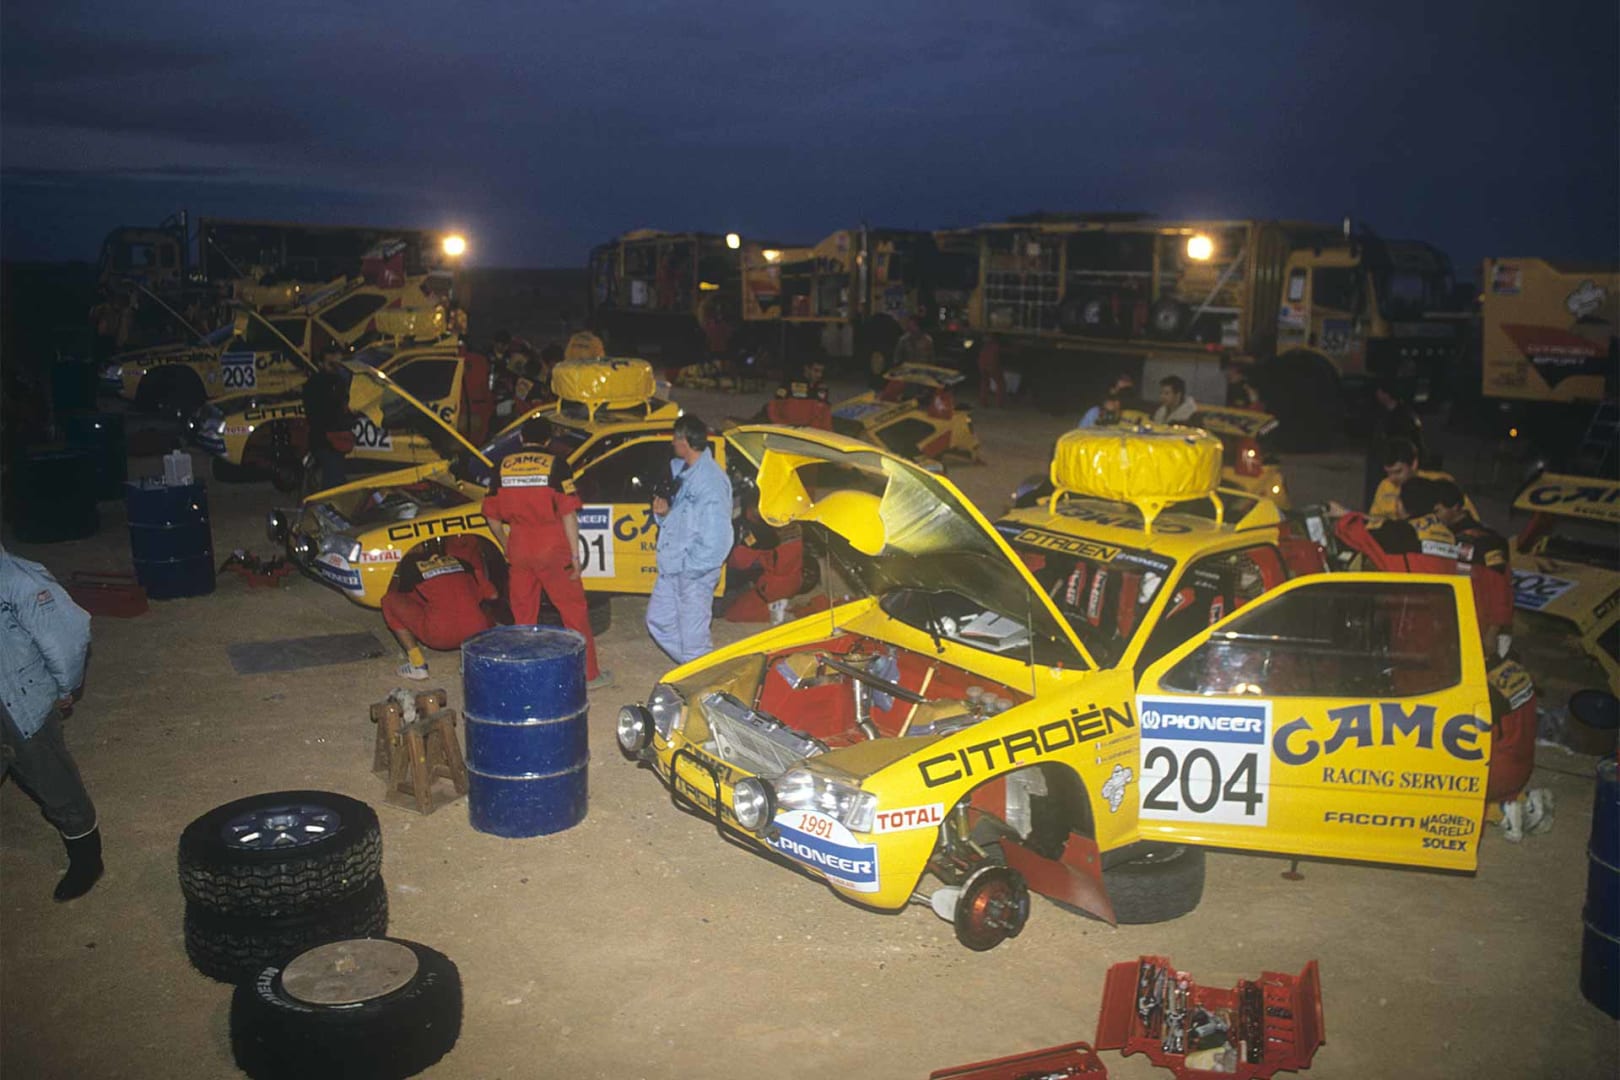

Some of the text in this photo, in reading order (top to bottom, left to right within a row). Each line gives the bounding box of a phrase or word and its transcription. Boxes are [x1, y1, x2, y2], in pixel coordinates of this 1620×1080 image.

[223, 366, 255, 388] 203
[352, 419, 391, 448] 202
[503, 455, 550, 469] CAMEL
[361, 551, 400, 561] TOTAL
[1161, 714, 1263, 733] PIONEER
[918, 701, 1135, 789] CITROËN
[1142, 746, 1264, 816] 204
[1322, 766, 1481, 793] RACING SERVICE
[797, 813, 835, 840] 1991
[876, 806, 942, 830] TOTAL
[1419, 813, 1475, 831] MAGNETI
[780, 836, 874, 874] PIONEER
[1422, 837, 1467, 852] SOLEX
